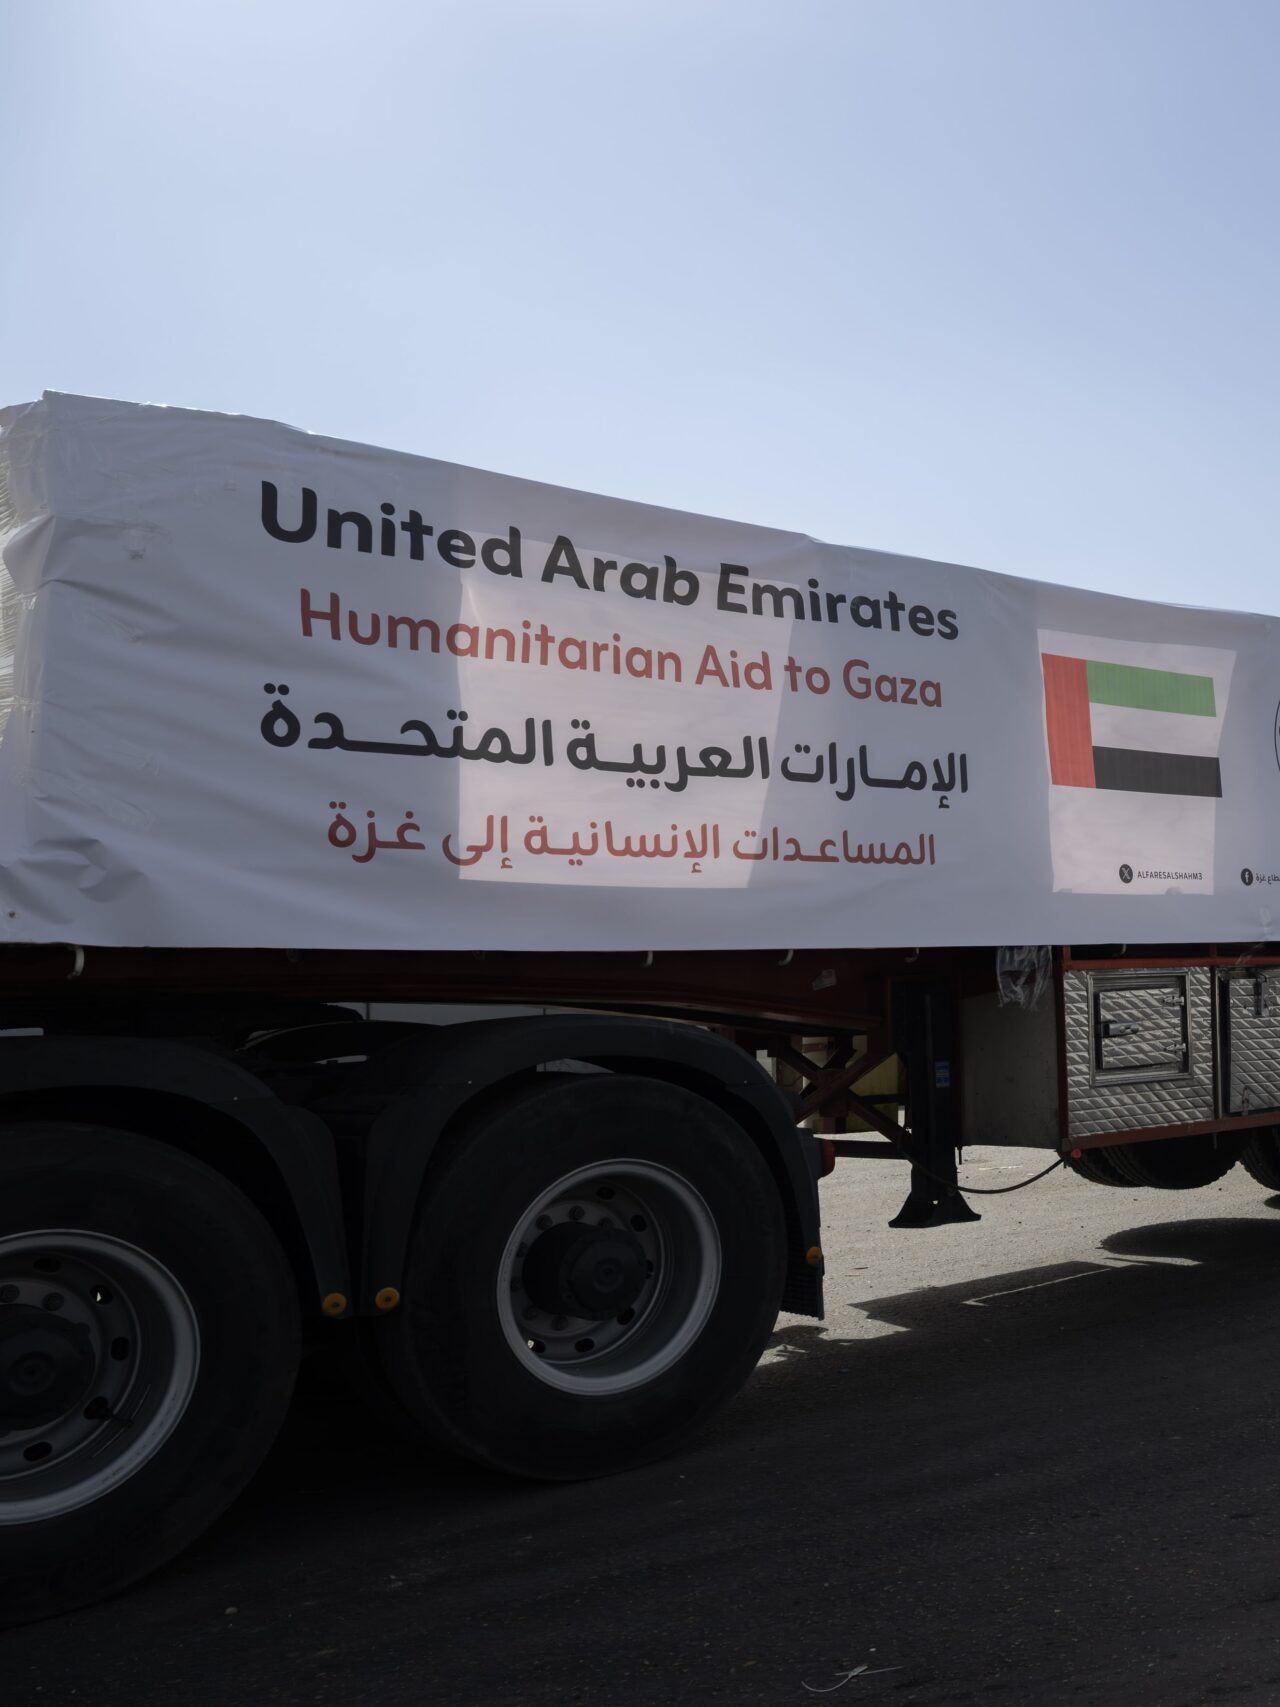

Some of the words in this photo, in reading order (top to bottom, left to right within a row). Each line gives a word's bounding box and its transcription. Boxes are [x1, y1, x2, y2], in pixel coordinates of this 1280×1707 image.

[261, 480, 523, 579] United
[541, 535, 700, 607] Arab
[717, 563, 959, 641] Emirates
[300, 588, 682, 683] Humanitarian
[695, 645, 773, 691] Aid
[784, 656, 831, 695] to
[842, 659, 943, 708] Gaza
[260, 683, 555, 767] المتحدة
[566, 719, 771, 793] العربية
[781, 742, 969, 809] الإمارات
[327, 800, 427, 864] غزة
[442, 815, 513, 869] إلى
[523, 814, 720, 874] الإنسانية
[733, 828, 936, 866] المساعدات
[1137, 870, 1203, 881] ALFARESALSHAHM3
